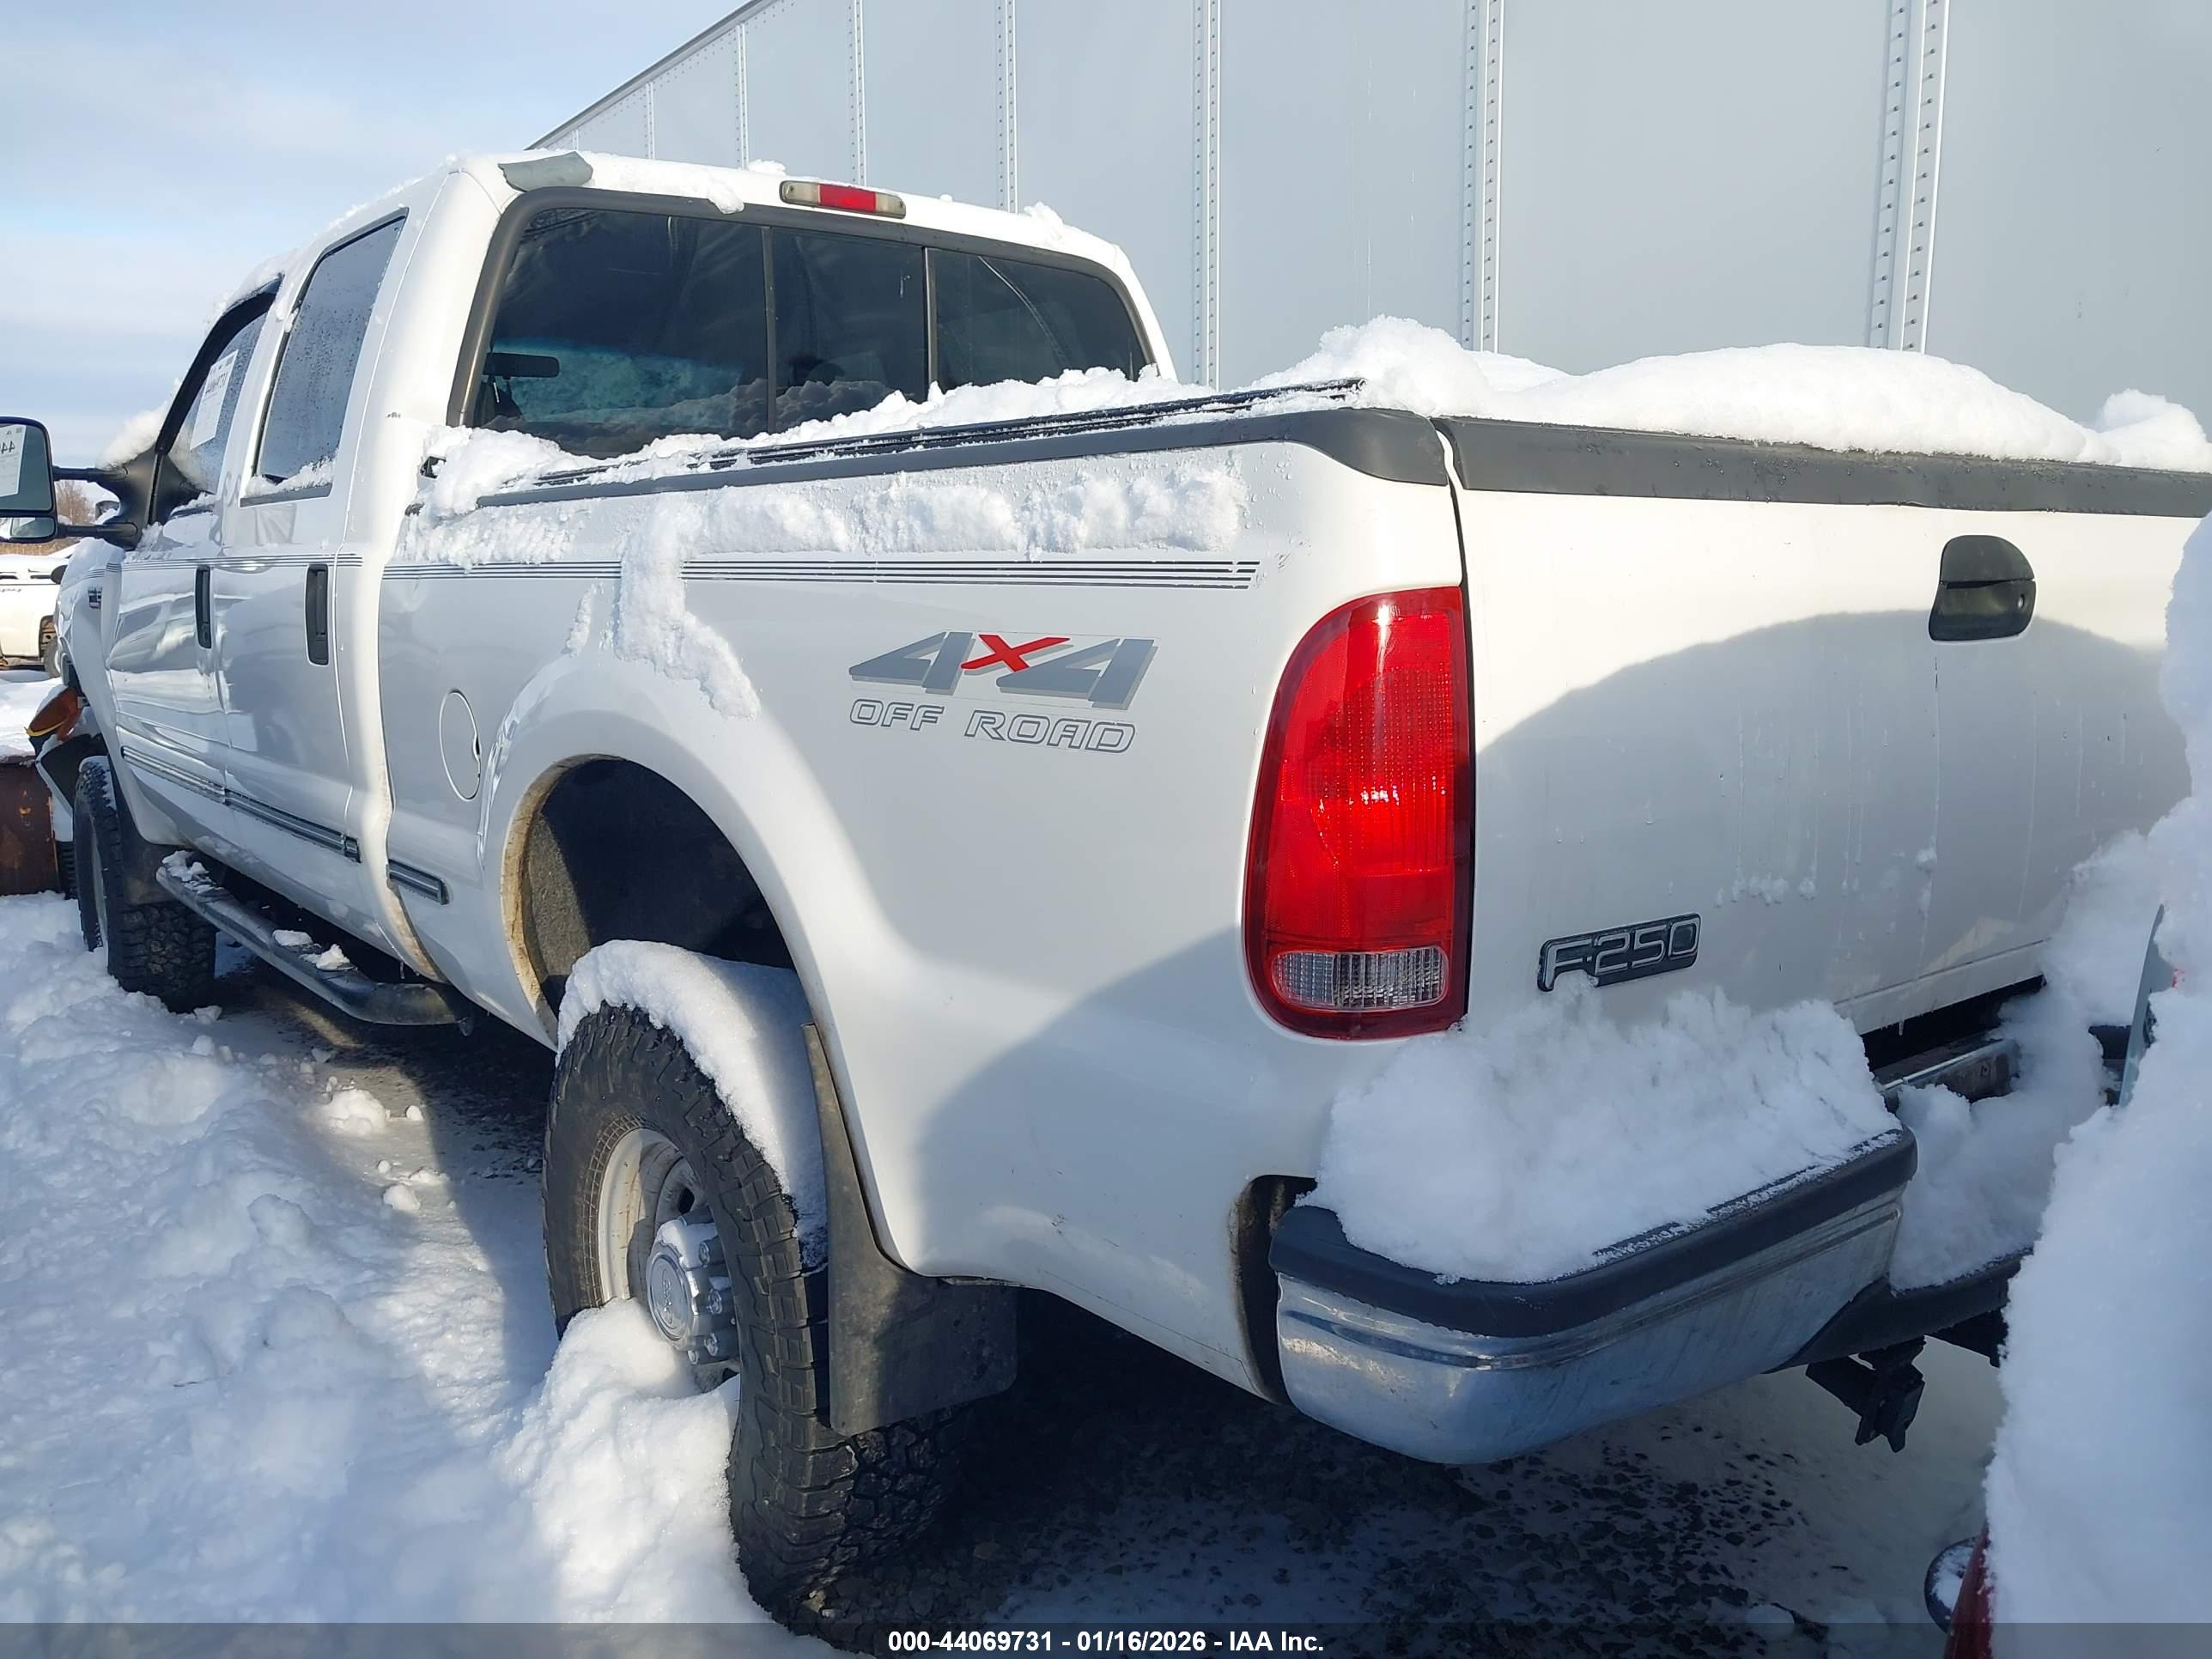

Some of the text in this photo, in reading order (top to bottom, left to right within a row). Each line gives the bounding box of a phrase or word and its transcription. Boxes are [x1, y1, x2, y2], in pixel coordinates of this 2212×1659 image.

[849, 698, 1136, 753] OFF ROAD
[1543, 916, 1700, 990] F-250
